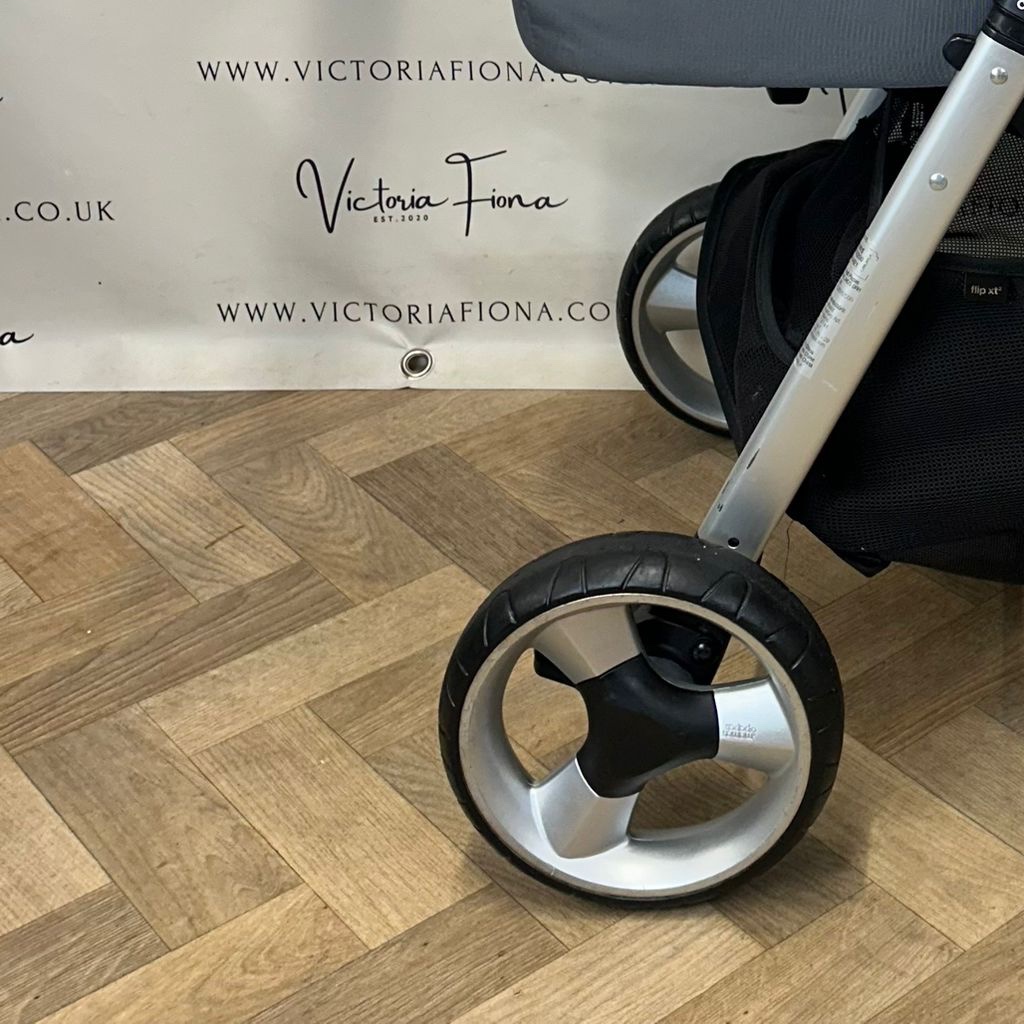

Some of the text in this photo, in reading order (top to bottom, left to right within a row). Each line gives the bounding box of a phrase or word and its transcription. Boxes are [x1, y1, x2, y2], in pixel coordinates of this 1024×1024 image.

[296, 150, 568, 237] Victoria Fiona
[373, 214, 429, 223] EST.2020
